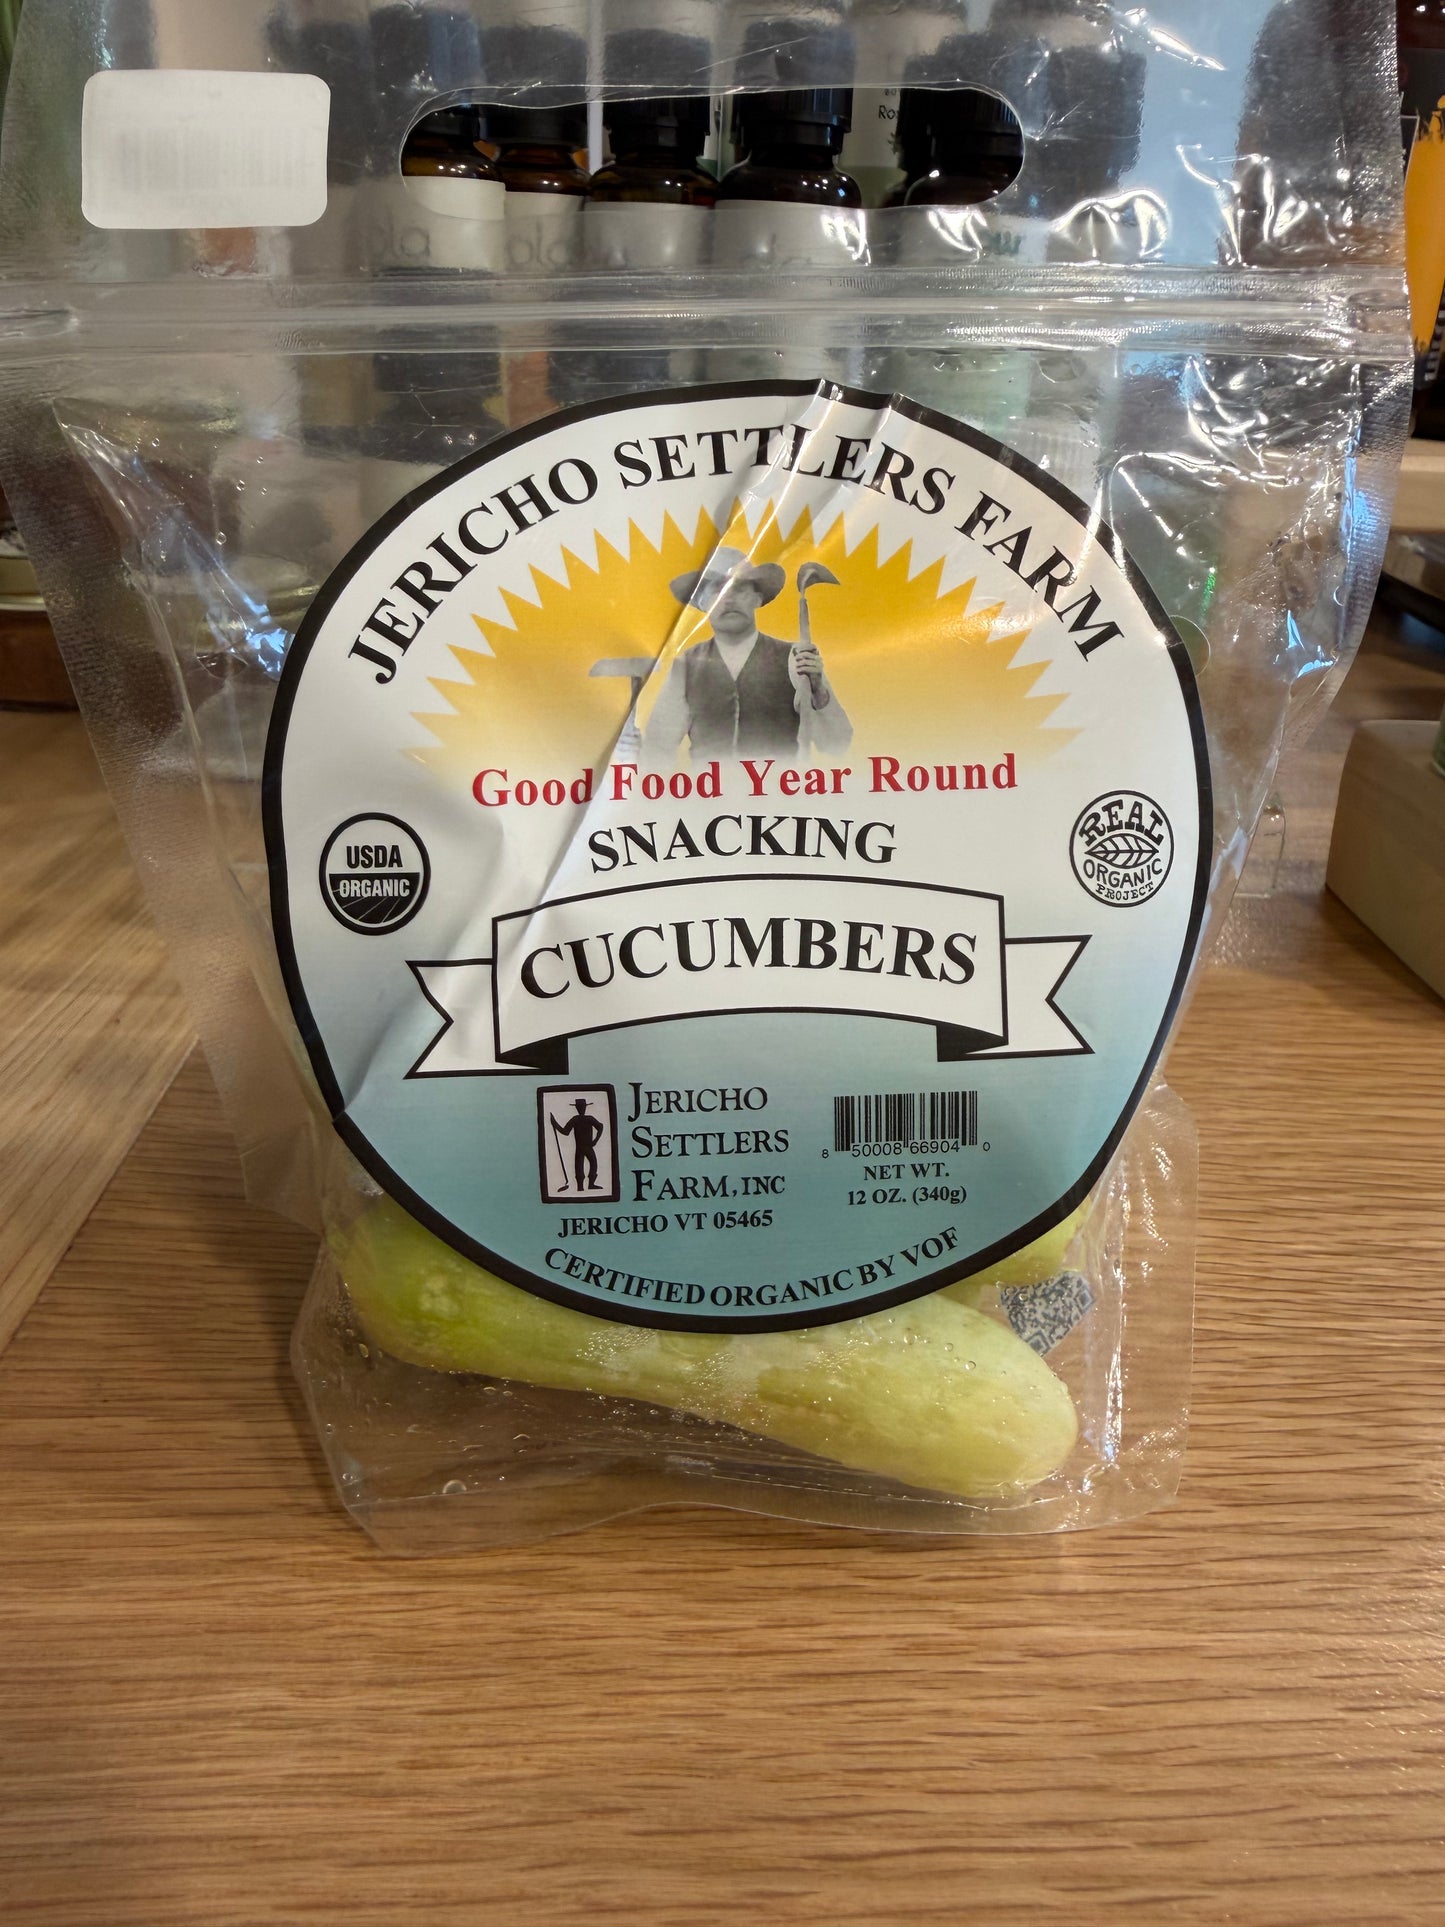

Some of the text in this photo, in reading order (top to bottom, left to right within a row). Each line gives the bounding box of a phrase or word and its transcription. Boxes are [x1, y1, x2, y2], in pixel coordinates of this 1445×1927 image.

[348, 423, 1125, 684] JERICHO SETTLERS FARM
[473, 753, 1018, 807] Good Food Year Round
[1079, 799, 1164, 847] REAL
[346, 845, 403, 869] USDA
[588, 814, 897, 873] SNACKING
[339, 879, 410, 898] ORGANIC
[1083, 858, 1162, 888] ORGANIC
[1095, 881, 1154, 900] PROJECT
[520, 917, 977, 998] CUCUMBERS
[627, 1082, 768, 1122] JERICHO
[631, 1126, 789, 1158] SETTLERS
[822, 1150, 829, 1159] 8
[983, 1141, 990, 1151] 0
[864, 1162, 950, 1181] NET WT.
[847, 1186, 967, 1206] 12 OZ. (340g)
[558, 1209, 773, 1238] JERICHO VT 05465
[545, 1226, 959, 1307] CERTIFIED ORGANIC BY VOF
